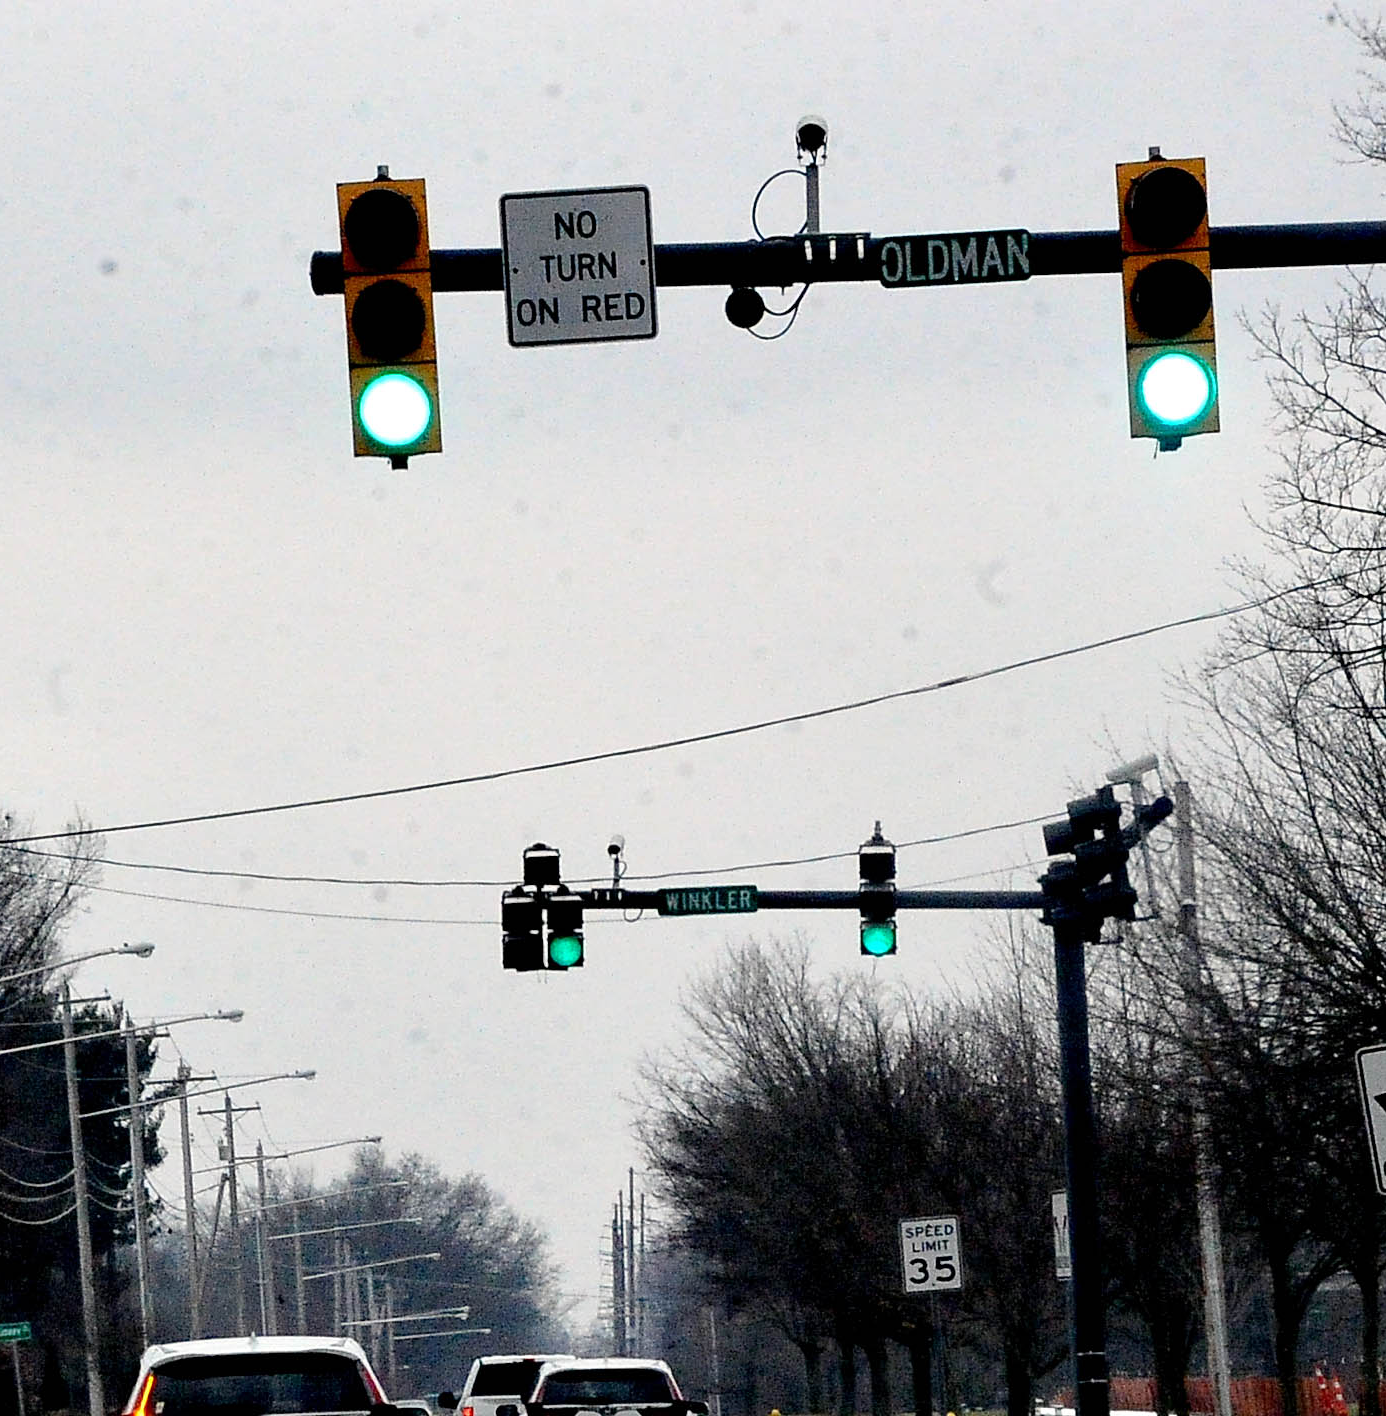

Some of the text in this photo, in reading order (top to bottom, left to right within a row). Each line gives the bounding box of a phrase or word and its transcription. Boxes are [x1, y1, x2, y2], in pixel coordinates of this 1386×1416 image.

[554, 210, 597, 240] NO
[539, 251, 617, 283] TURN
[881, 233, 1030, 282] OLDMAN
[516, 292, 645, 326] ON RED
[666, 890, 753, 911] WINKLER
[905, 1224, 954, 1238] SPEED
[912, 1239, 949, 1253] LIMIT
[909, 1255, 956, 1284] 35
